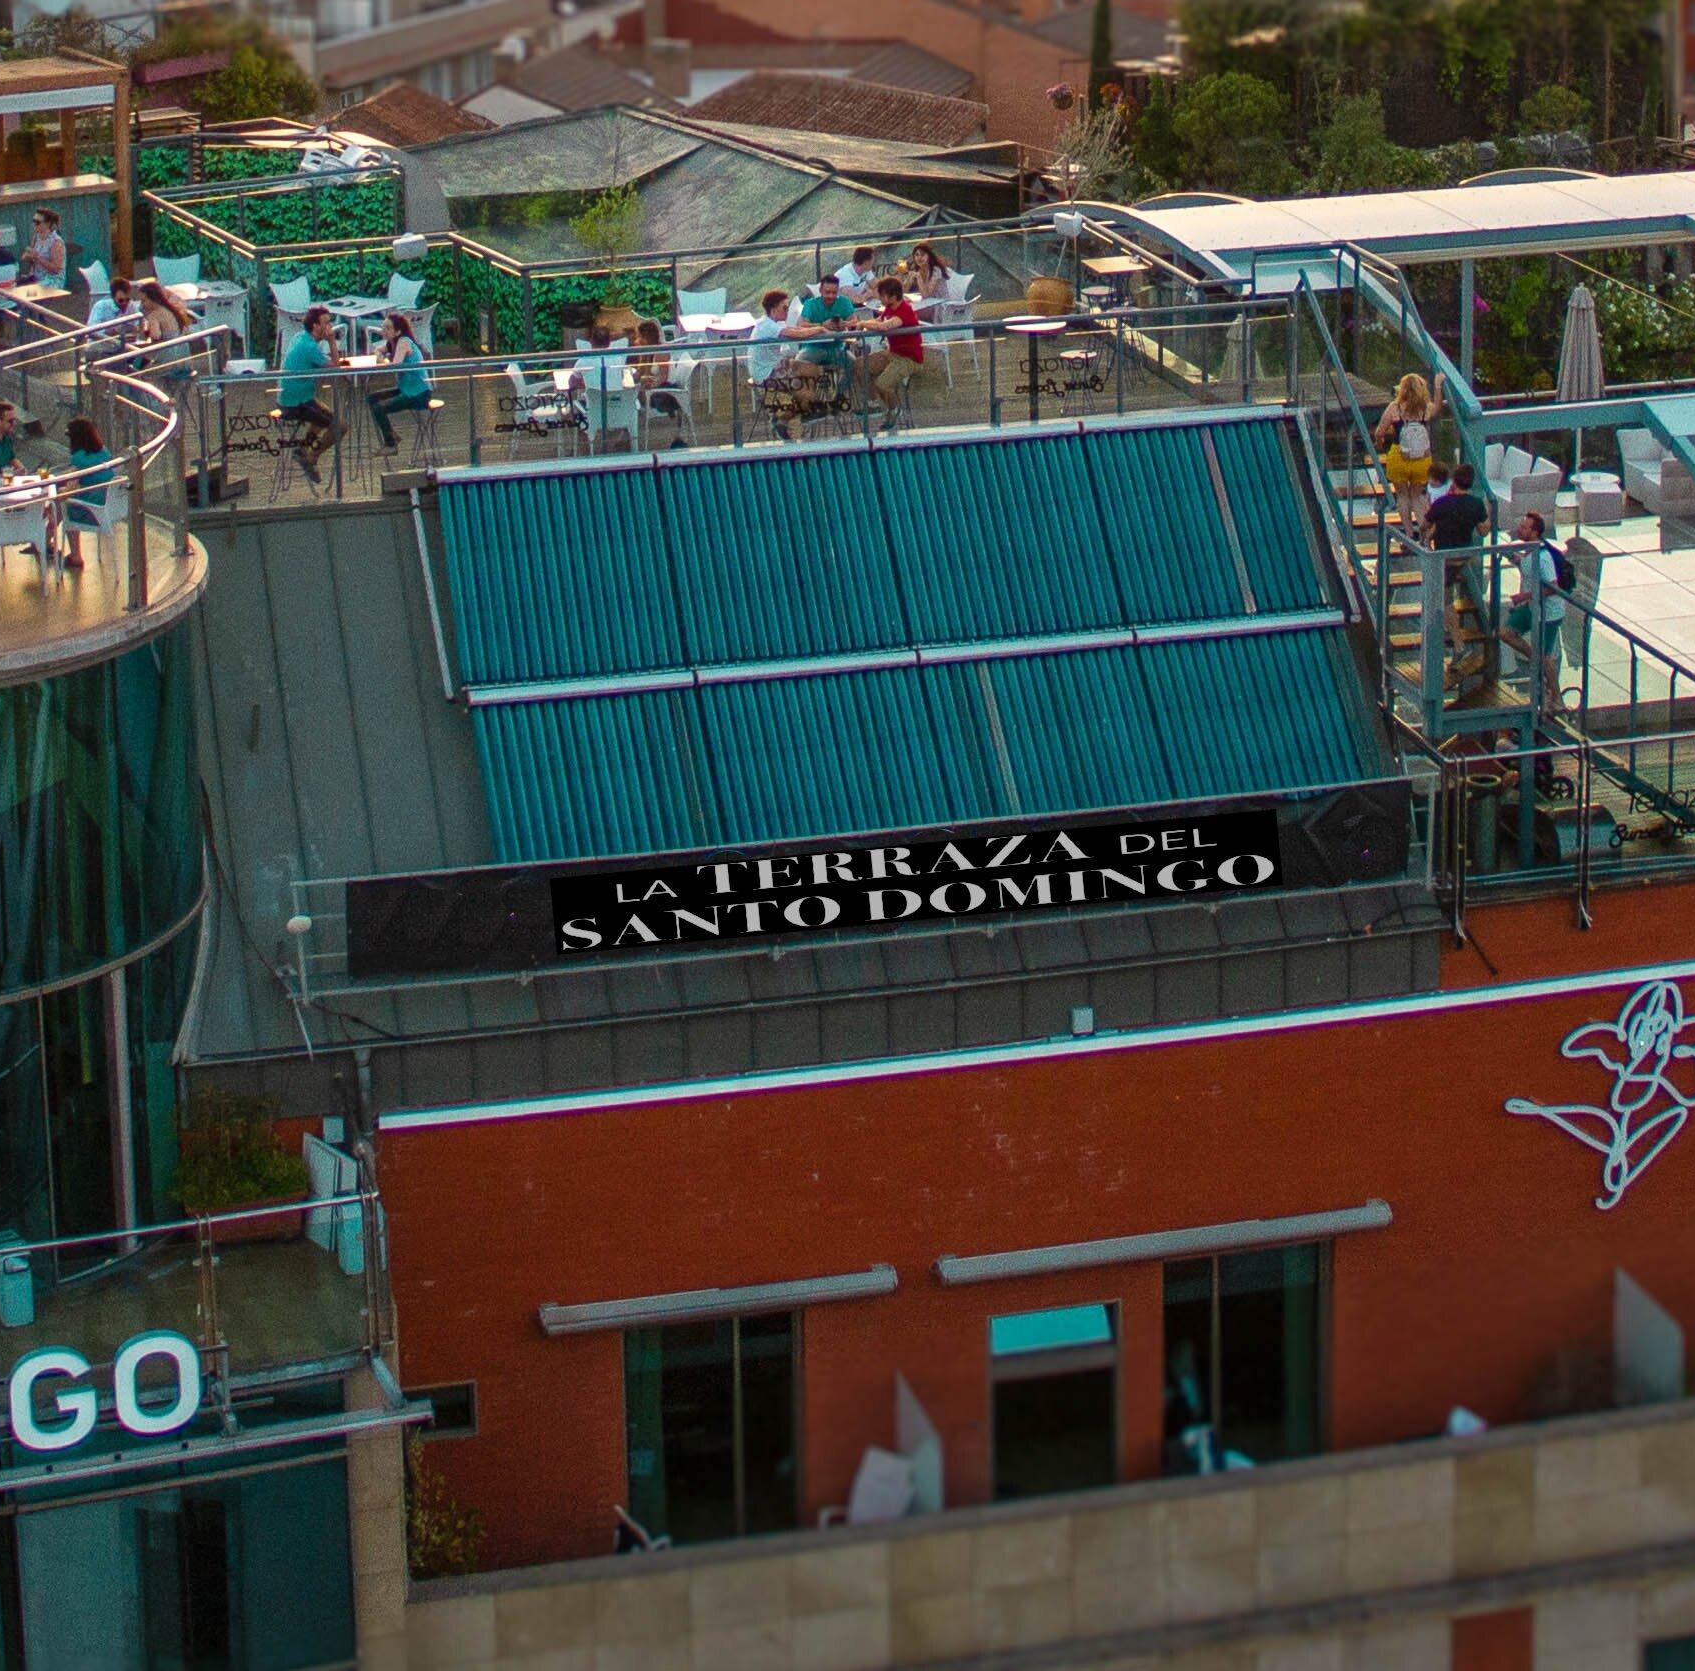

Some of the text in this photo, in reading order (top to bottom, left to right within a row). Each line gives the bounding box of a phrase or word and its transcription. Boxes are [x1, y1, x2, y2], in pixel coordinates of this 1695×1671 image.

[561, 854, 1275, 951] SANTO DOMINGO
[615, 828, 1218, 904] LA TERRAZA DEL
